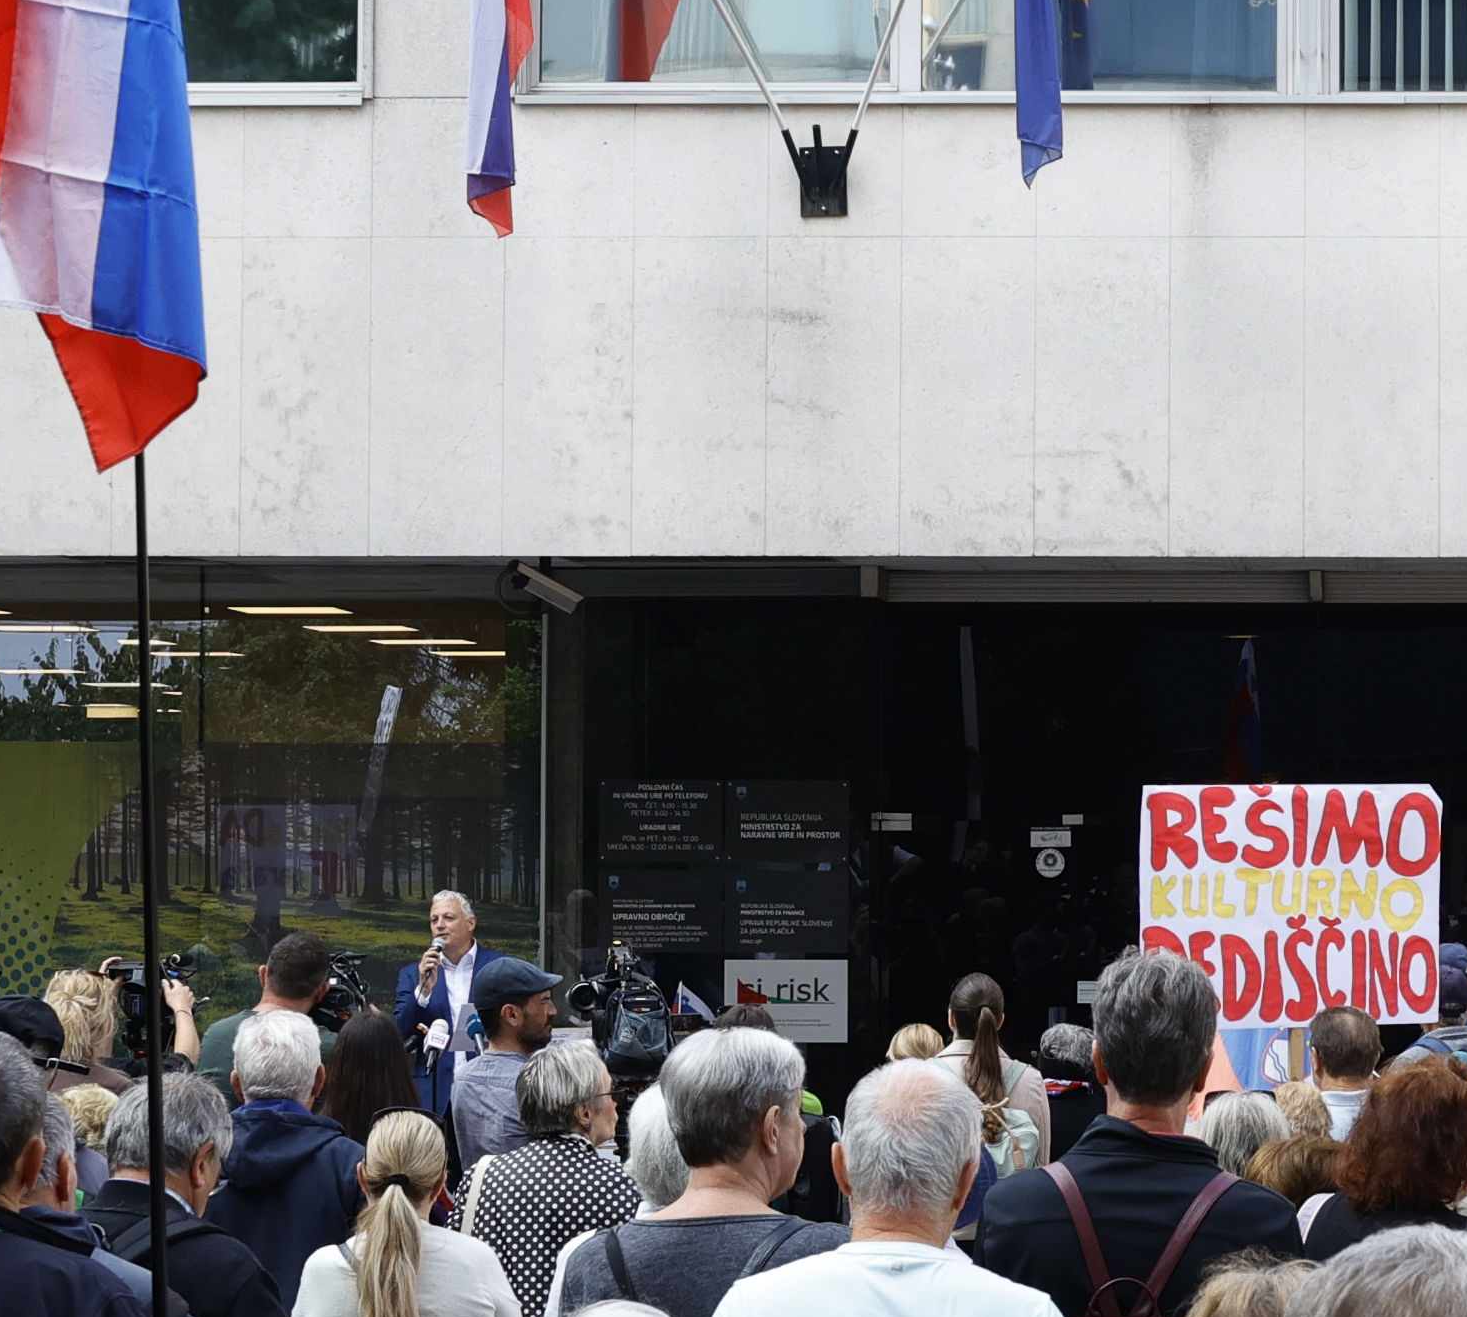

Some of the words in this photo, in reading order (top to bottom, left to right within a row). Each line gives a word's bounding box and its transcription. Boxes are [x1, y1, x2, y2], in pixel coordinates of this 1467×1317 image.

[671, 782, 683, 791] ČAS
[740, 813, 783, 821] REPUBLIKA
[783, 813, 823, 821] SLOVENIJA
[740, 823, 790, 831] MINISTRSTVO
[791, 823, 801, 831] ZA
[1147, 784, 1441, 876] REŠIMO
[740, 831, 776, 839] NARAVNE
[777, 831, 795, 839] VIRE
[796, 831, 805, 839] IN
[805, 831, 841, 839] PROSTOR
[1150, 867, 1423, 933] KULTURNO
[613, 913, 649, 921] UPRAVNO
[651, 912, 686, 922] OBMOČJE
[765, 919, 800, 927] REPUBLIKE
[739, 927, 749, 935] ZA
[749, 927, 769, 935] JAVNA
[769, 927, 795, 935] PLAČILA
